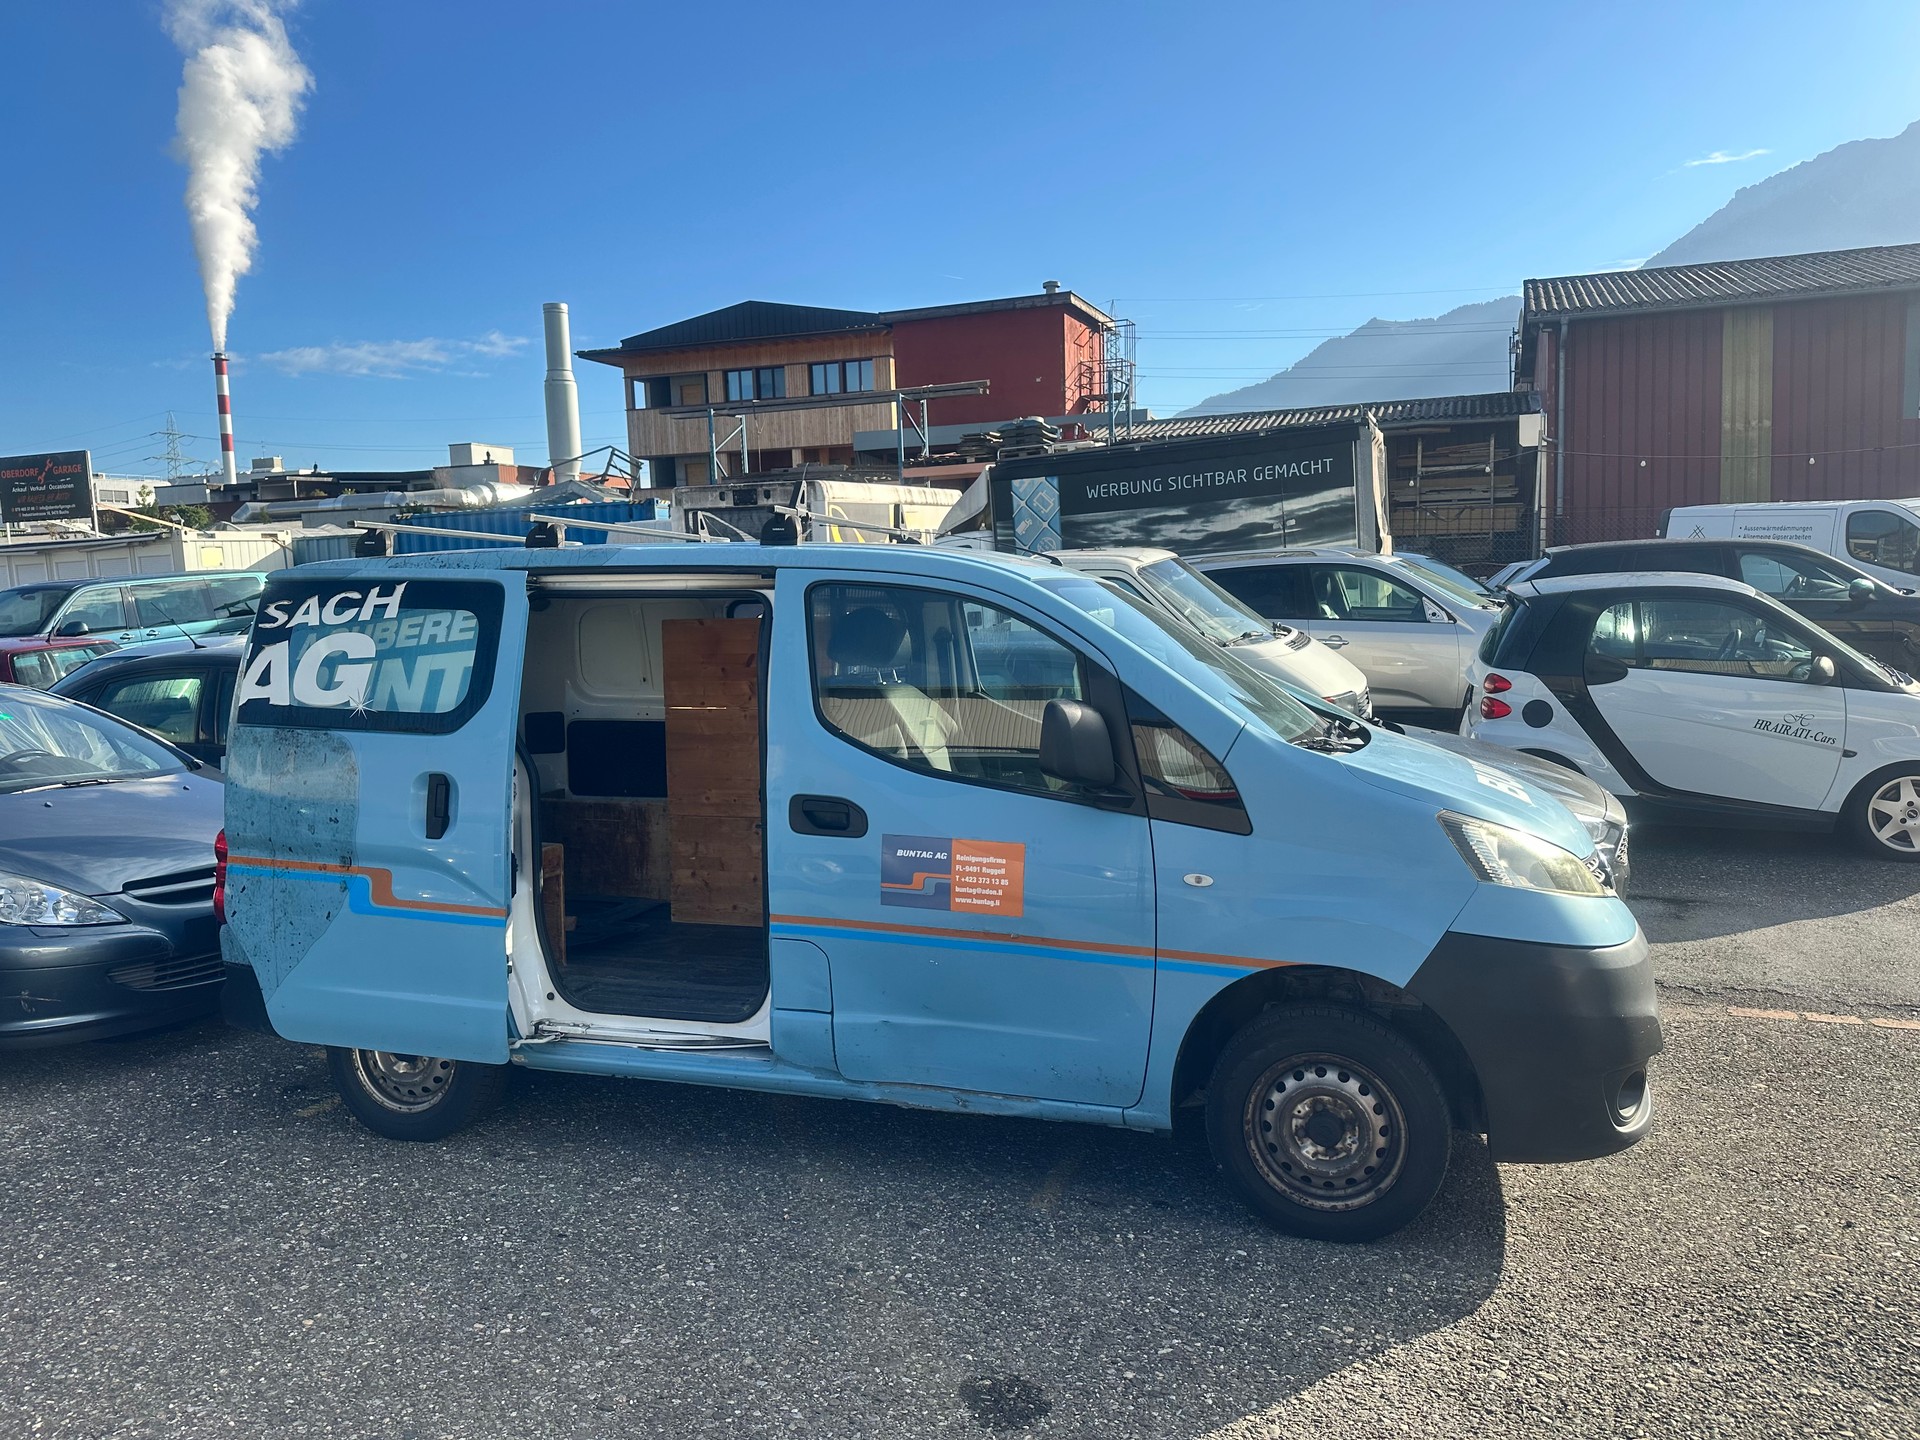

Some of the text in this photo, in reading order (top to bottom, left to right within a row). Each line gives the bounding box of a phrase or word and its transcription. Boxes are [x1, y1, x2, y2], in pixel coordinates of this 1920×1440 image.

[1, 464, 82, 479] OBERDORF GARAGE
[1086, 457, 1334, 499] WERBUNG SICHTBAR GEMACHT
[258, 581, 408, 629] SACH
[239, 632, 377, 706] AG
[1753, 719, 1836, 745] HRAIRATI-Cars
[896, 849, 948, 860] BUNTAG AG
[956, 854, 1006, 864] Reinigungsfirma
[955, 864, 1006, 875] FL-9491 Ruggell
[955, 885, 1003, 896] buntag@adon.li
[955, 896, 1001, 907] www.buntag.li
